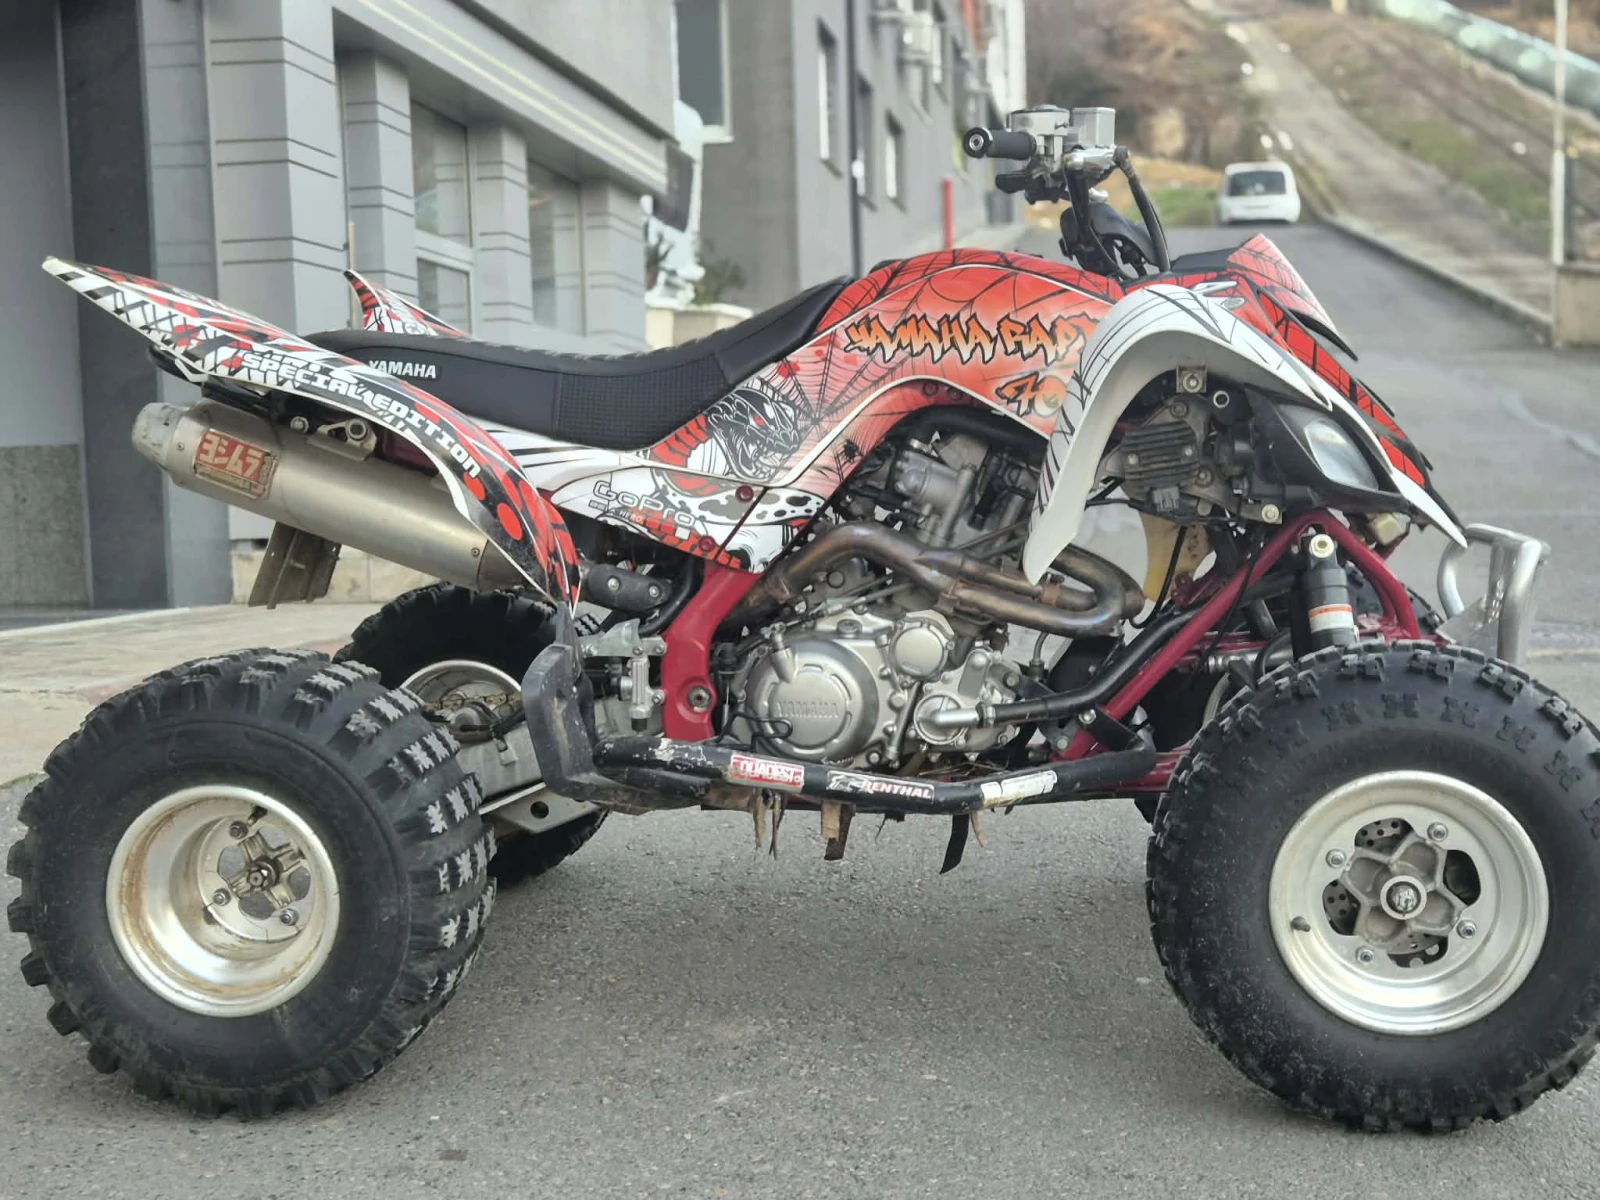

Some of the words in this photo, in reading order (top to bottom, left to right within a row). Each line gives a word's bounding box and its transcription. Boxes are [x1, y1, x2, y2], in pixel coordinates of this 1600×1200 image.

[844, 312, 998, 365] YAMAHA
[368, 360, 437, 379] YAMAHA
[242, 351, 371, 403] SPECIAL
[371, 391, 482, 479] EDITION
[199, 432, 264, 478] ヨシムラ
[593, 480, 697, 528] GoPro
[776, 700, 839, 719] YAMAHA
[861, 779, 932, 800] RENTHAL
